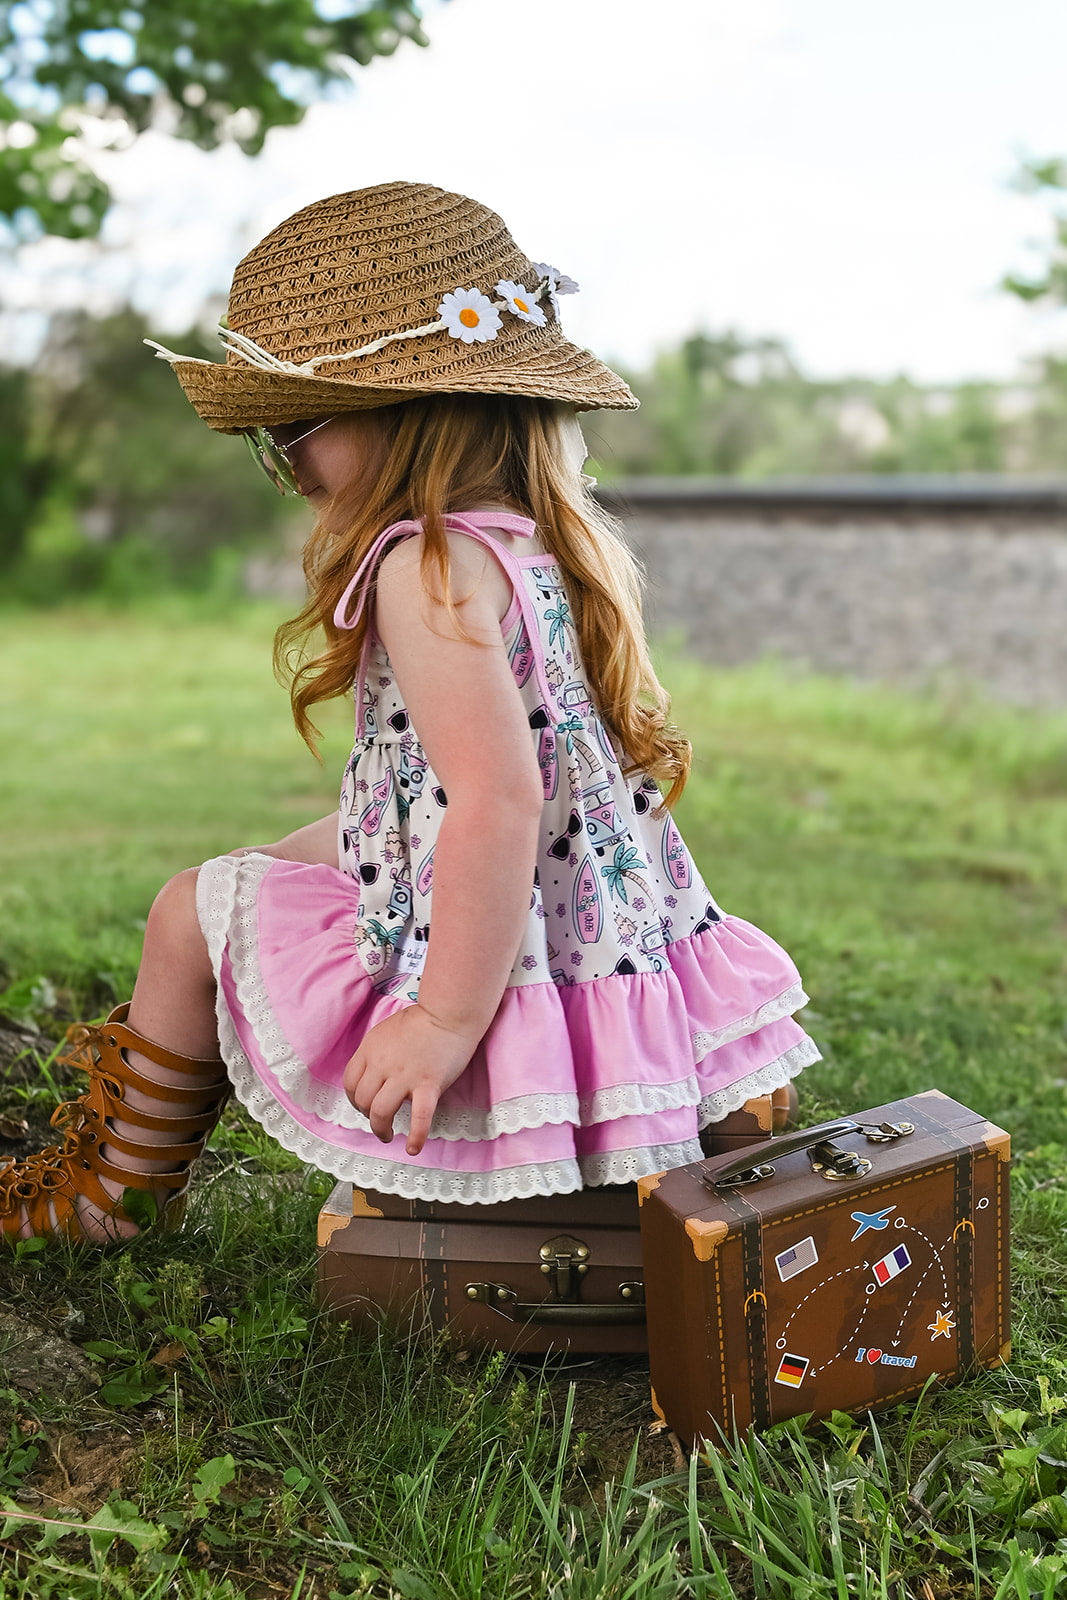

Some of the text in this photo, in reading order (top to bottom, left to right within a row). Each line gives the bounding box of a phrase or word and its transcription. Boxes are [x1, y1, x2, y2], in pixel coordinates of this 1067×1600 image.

[515, 655, 528, 677] BEACH
[544, 736, 554, 789] BEACH BUM
[676, 860, 685, 879] BEACH
[583, 879, 594, 932] BEACH BUM
[855, 1348, 917, 1368] I travel
